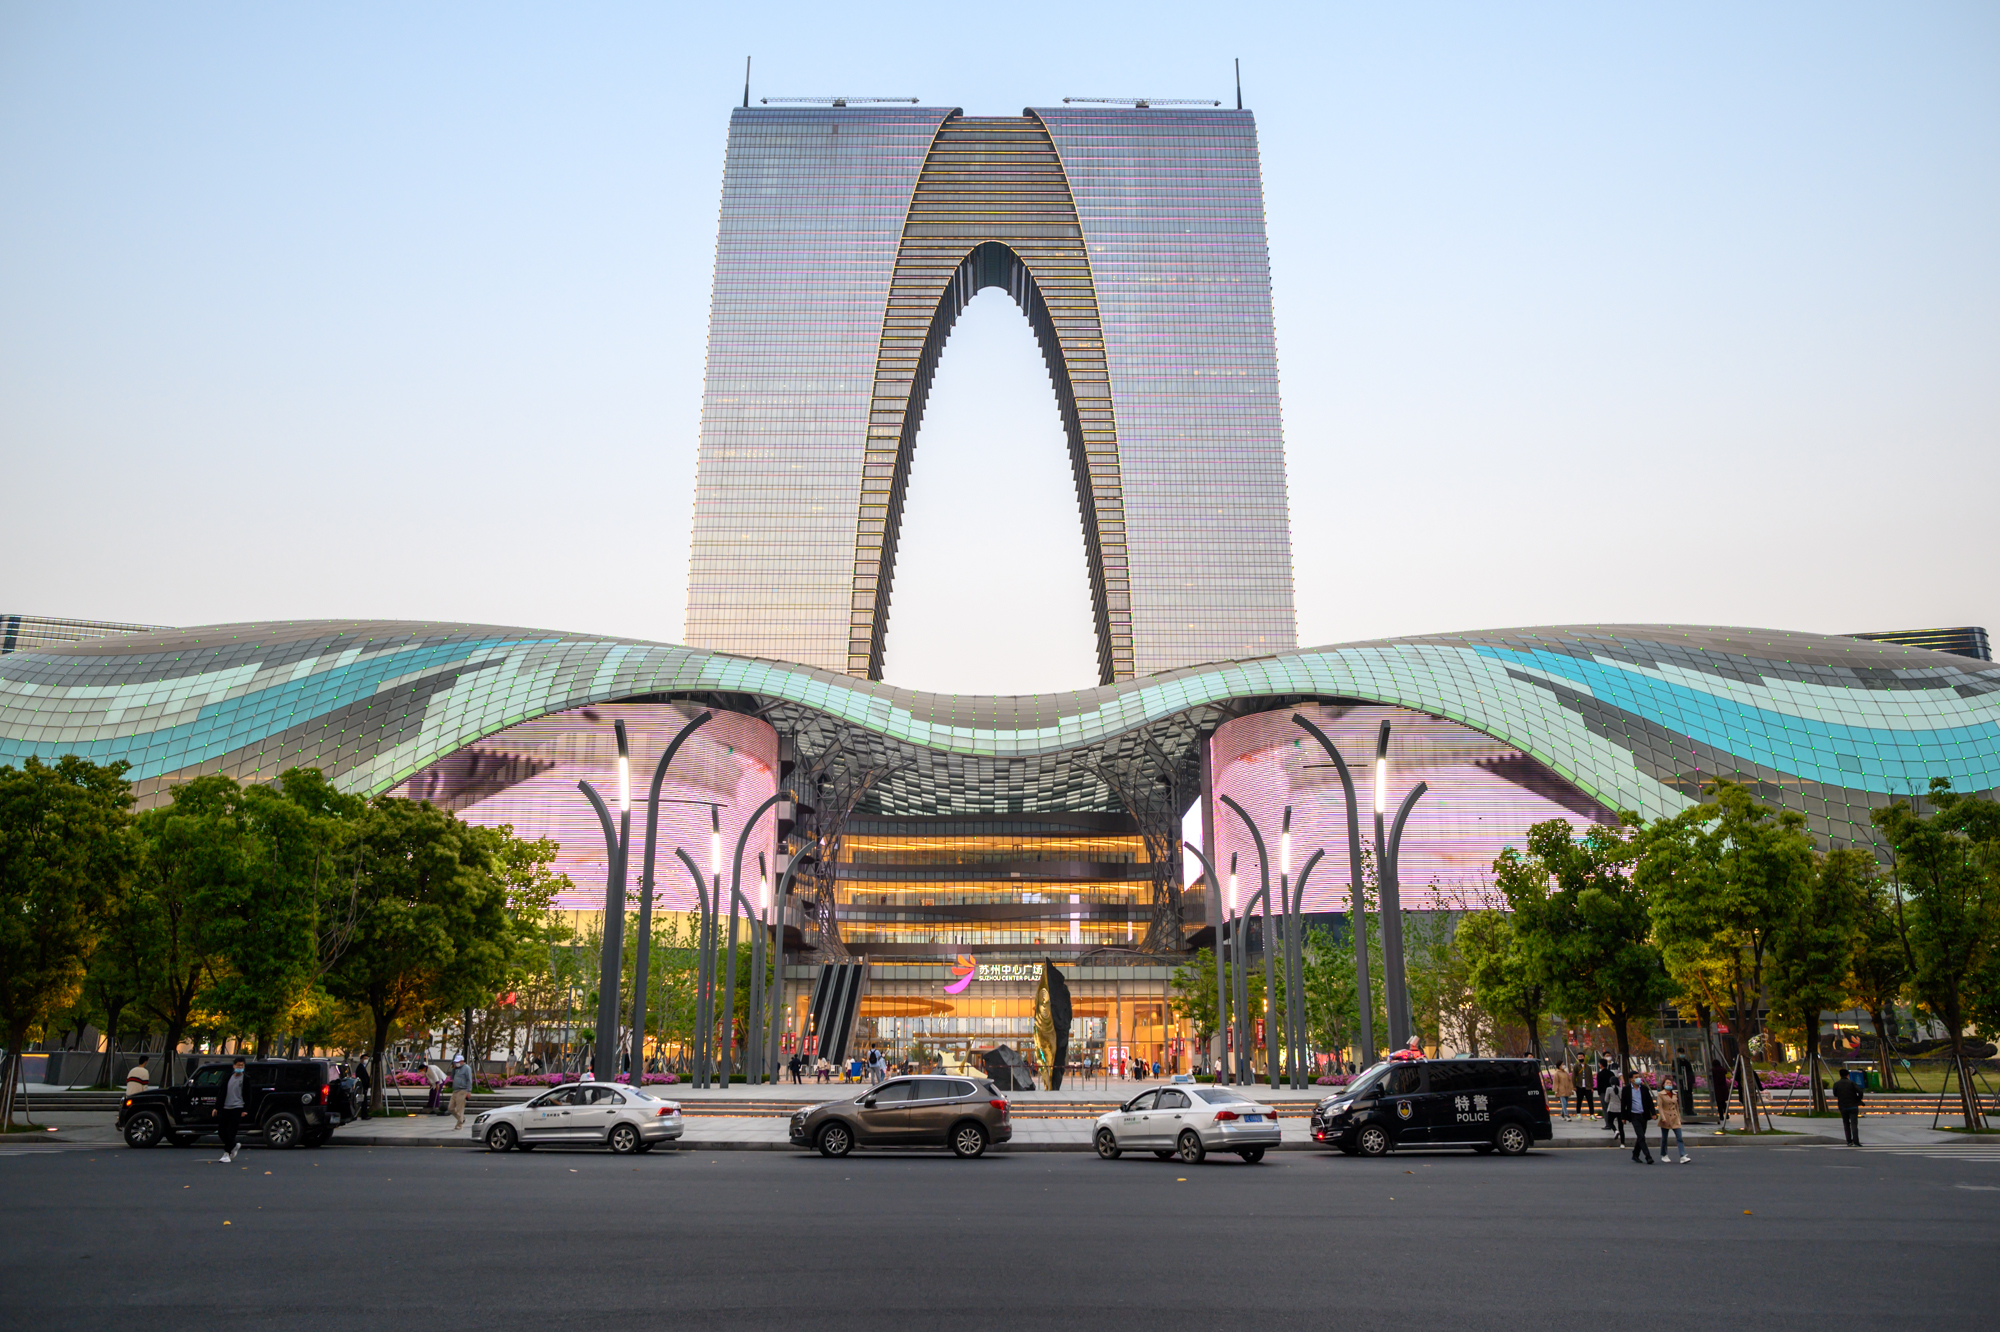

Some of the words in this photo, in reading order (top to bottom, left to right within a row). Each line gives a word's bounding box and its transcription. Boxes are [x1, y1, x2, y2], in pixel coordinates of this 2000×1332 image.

[979, 965, 1042, 975] 苏州中心广场
[1455, 1095, 1488, 1111] 特警
[1456, 1113, 1490, 1122] POLICE
